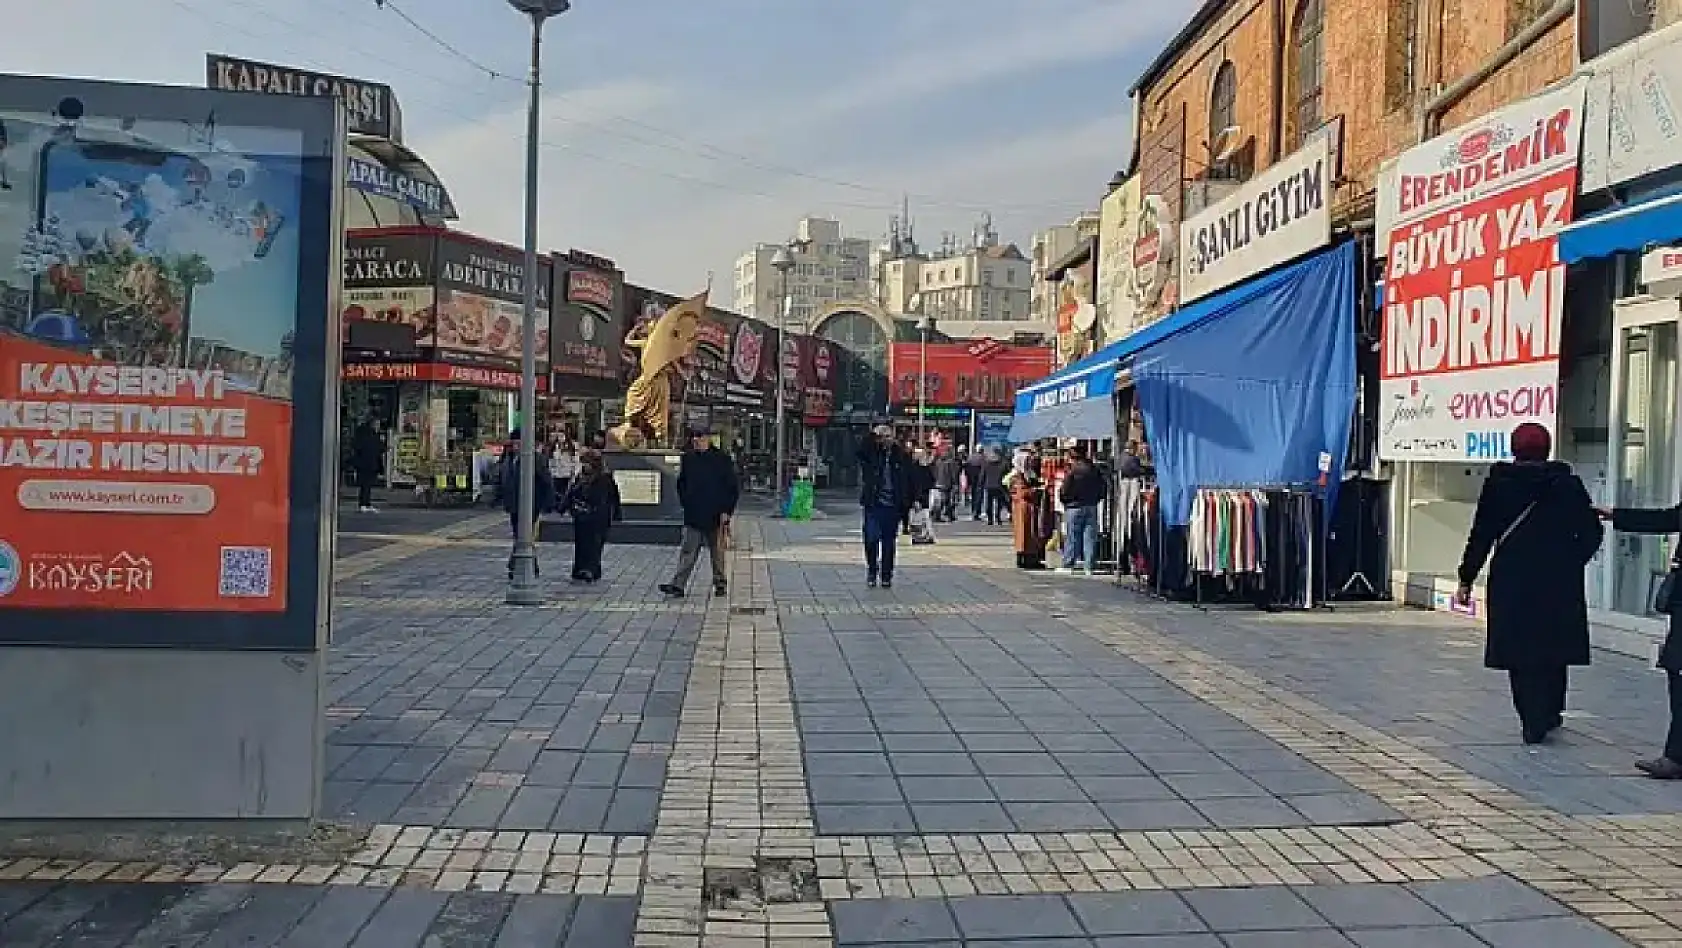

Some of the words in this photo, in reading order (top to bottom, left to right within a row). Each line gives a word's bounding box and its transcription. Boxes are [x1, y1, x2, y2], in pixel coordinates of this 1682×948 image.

[349, 159, 392, 190] APALI
[1400, 108, 1571, 212] ERENDEMİR
[1256, 158, 1323, 238] GİYİM
[1389, 210, 1487, 279] BÜYÜK
[1496, 188, 1569, 251] YAZ
[0, 401, 246, 438] KEŞFETMEYE
[1447, 384, 1555, 419] emsan
[0, 438, 93, 470] AZIR
[49, 488, 185, 505] www.kayseri.com.tr
